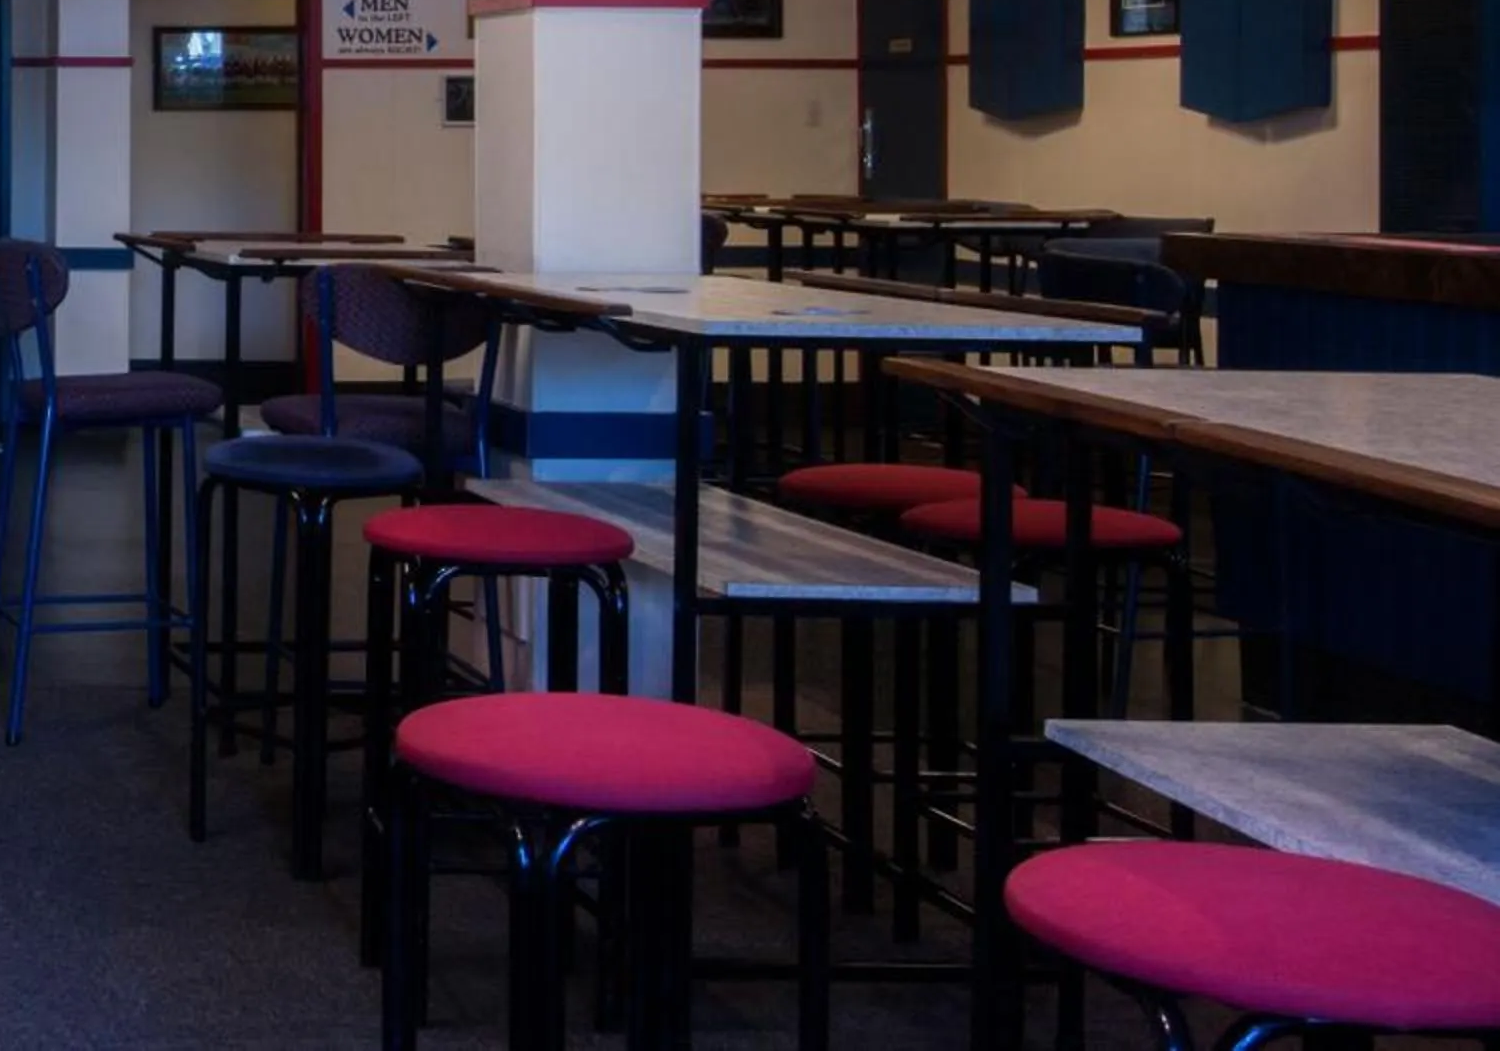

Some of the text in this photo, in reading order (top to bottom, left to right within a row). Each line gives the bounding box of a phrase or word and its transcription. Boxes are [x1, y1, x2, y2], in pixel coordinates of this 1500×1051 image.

[370, 13, 385, 22] the
[387, 13, 411, 22] LEFT
[337, 27, 423, 44] WOMEN
